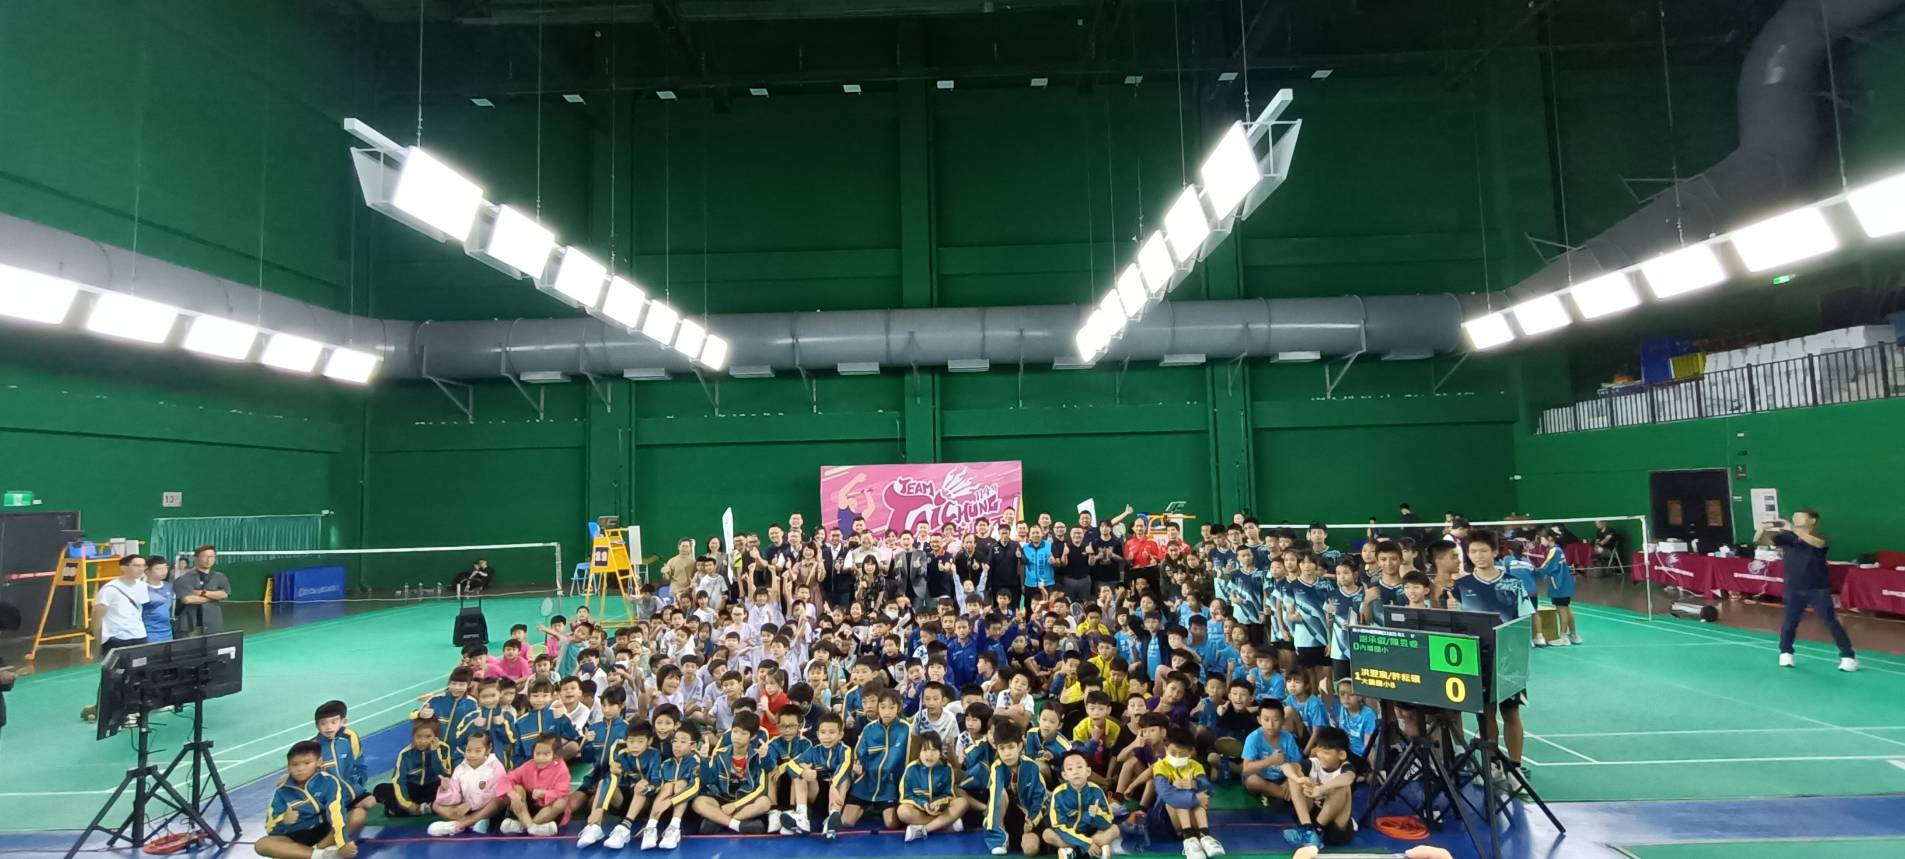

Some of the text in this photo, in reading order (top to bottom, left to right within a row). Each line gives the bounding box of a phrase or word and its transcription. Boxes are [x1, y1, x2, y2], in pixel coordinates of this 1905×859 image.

[899, 478, 934, 496] TEAM
[1352, 642, 1360, 650] 0
[1444, 643, 1463, 667] 0
[1354, 671, 1361, 681] 1
[1445, 677, 1466, 703] 0
